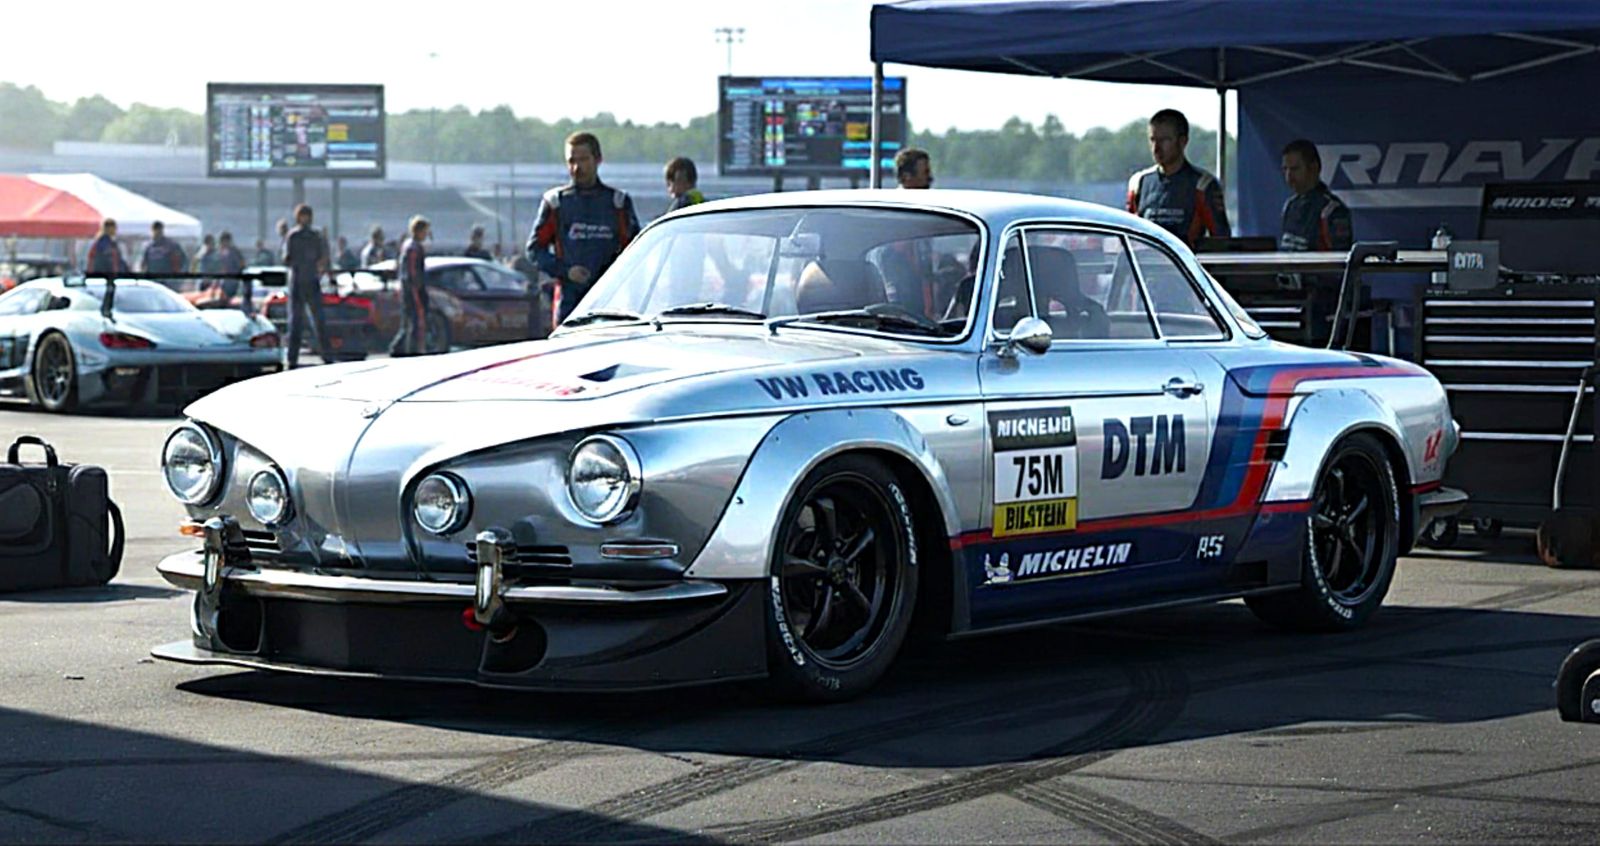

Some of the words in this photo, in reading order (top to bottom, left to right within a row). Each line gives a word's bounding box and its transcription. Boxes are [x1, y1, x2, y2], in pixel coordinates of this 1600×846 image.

[755, 376, 808, 399] VW
[811, 368, 924, 395] RACING
[1101, 414, 1186, 480] DTM
[1013, 454, 1063, 498] 75M
[1017, 542, 1132, 577] MICHELIN
